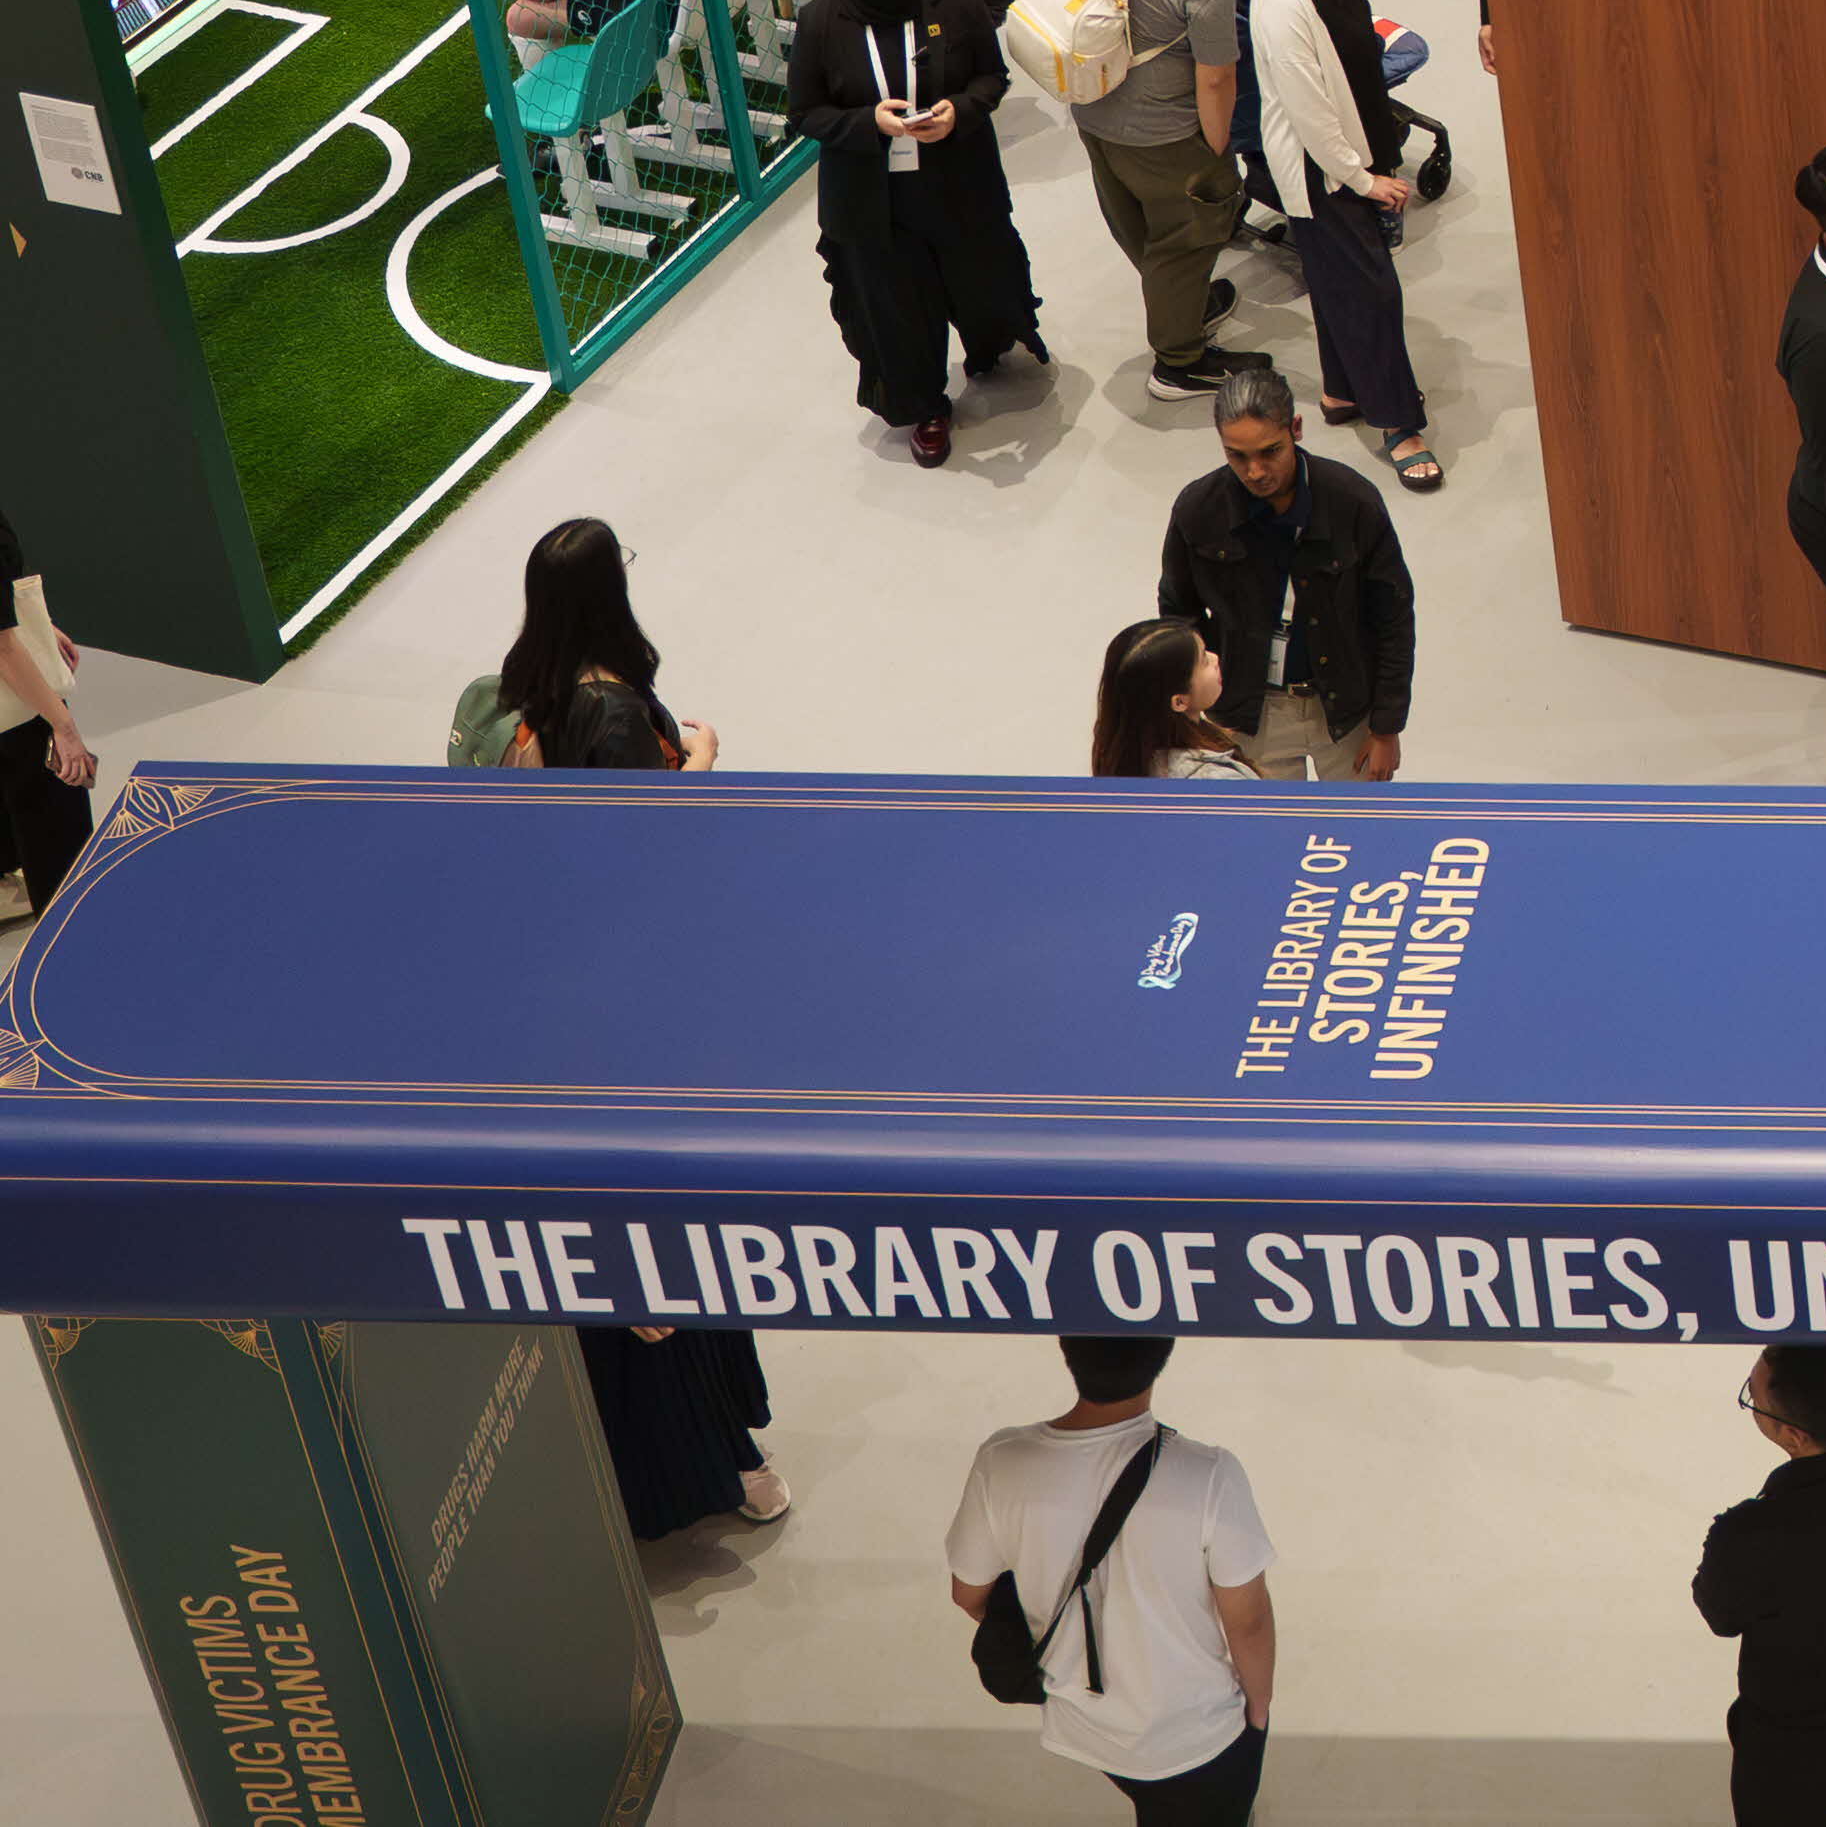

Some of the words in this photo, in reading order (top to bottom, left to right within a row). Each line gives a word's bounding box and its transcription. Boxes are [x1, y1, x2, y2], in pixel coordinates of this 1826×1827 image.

[1301, 834, 1352, 873] OF
[1257, 880, 1339, 1007] LIBRARY
[1308, 871, 1424, 1044] STORIES,
[1370, 838, 1490, 1079] UNFINISHED
[1236, 1016, 1299, 1078] THE
[402, 1219, 614, 1312] THE
[635, 1223, 1058, 1319] LIBRARY
[1095, 1231, 1216, 1322] OF
[1248, 1233, 1699, 1342] STORIES,
[428, 1505, 470, 1604] PEOPLE
[467, 1445, 496, 1515] THAN
[492, 1401, 515, 1455] YOU
[513, 1333, 543, 1411] THINK
[432, 1462, 469, 1548] DRUGS
[465, 1396, 497, 1471] HARM
[495, 1333, 525, 1407] MORE
[230, 1544, 299, 1614] DAY
[179, 1594, 275, 1735] VICTIMS
